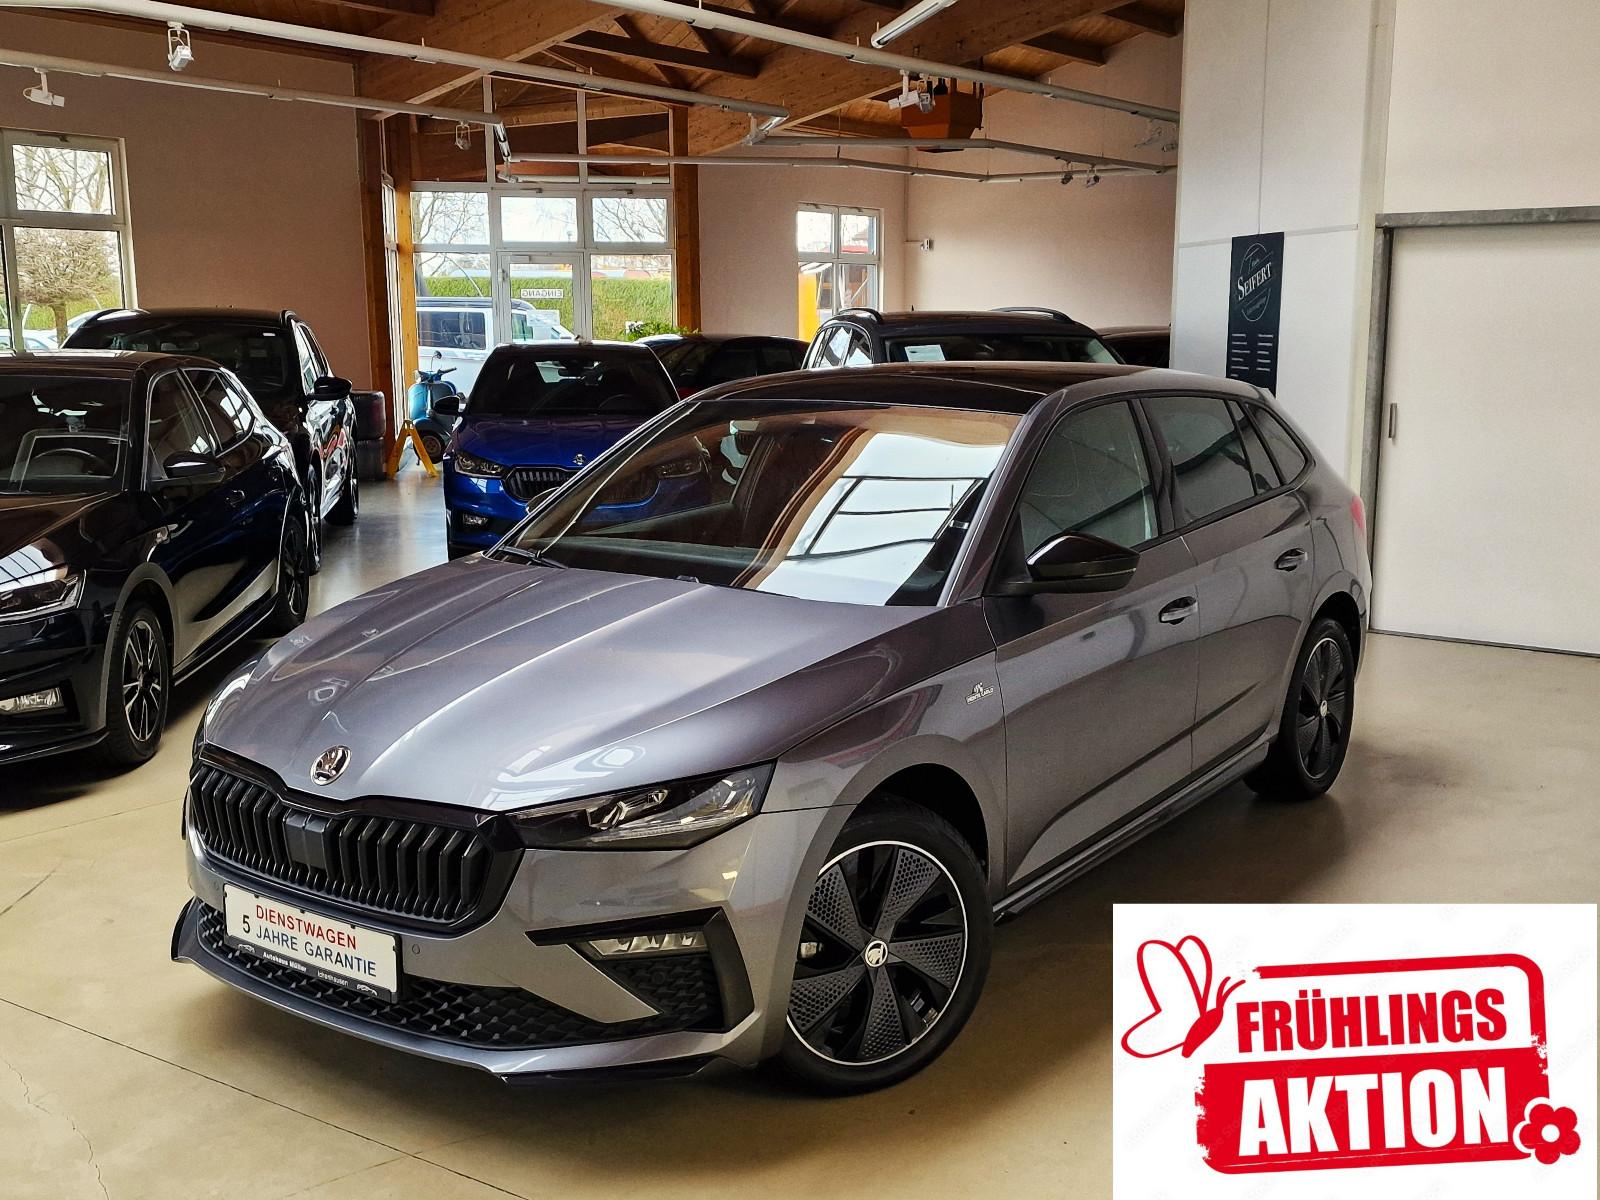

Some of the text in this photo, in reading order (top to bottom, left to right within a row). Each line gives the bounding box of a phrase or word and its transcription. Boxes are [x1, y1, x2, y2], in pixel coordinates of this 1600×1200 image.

[242, 914, 377, 977] 5 JAHRE GARANTIE
[256, 904, 357, 950] DIENSTWAGEN
[262, 951, 288, 966] Autohaus
